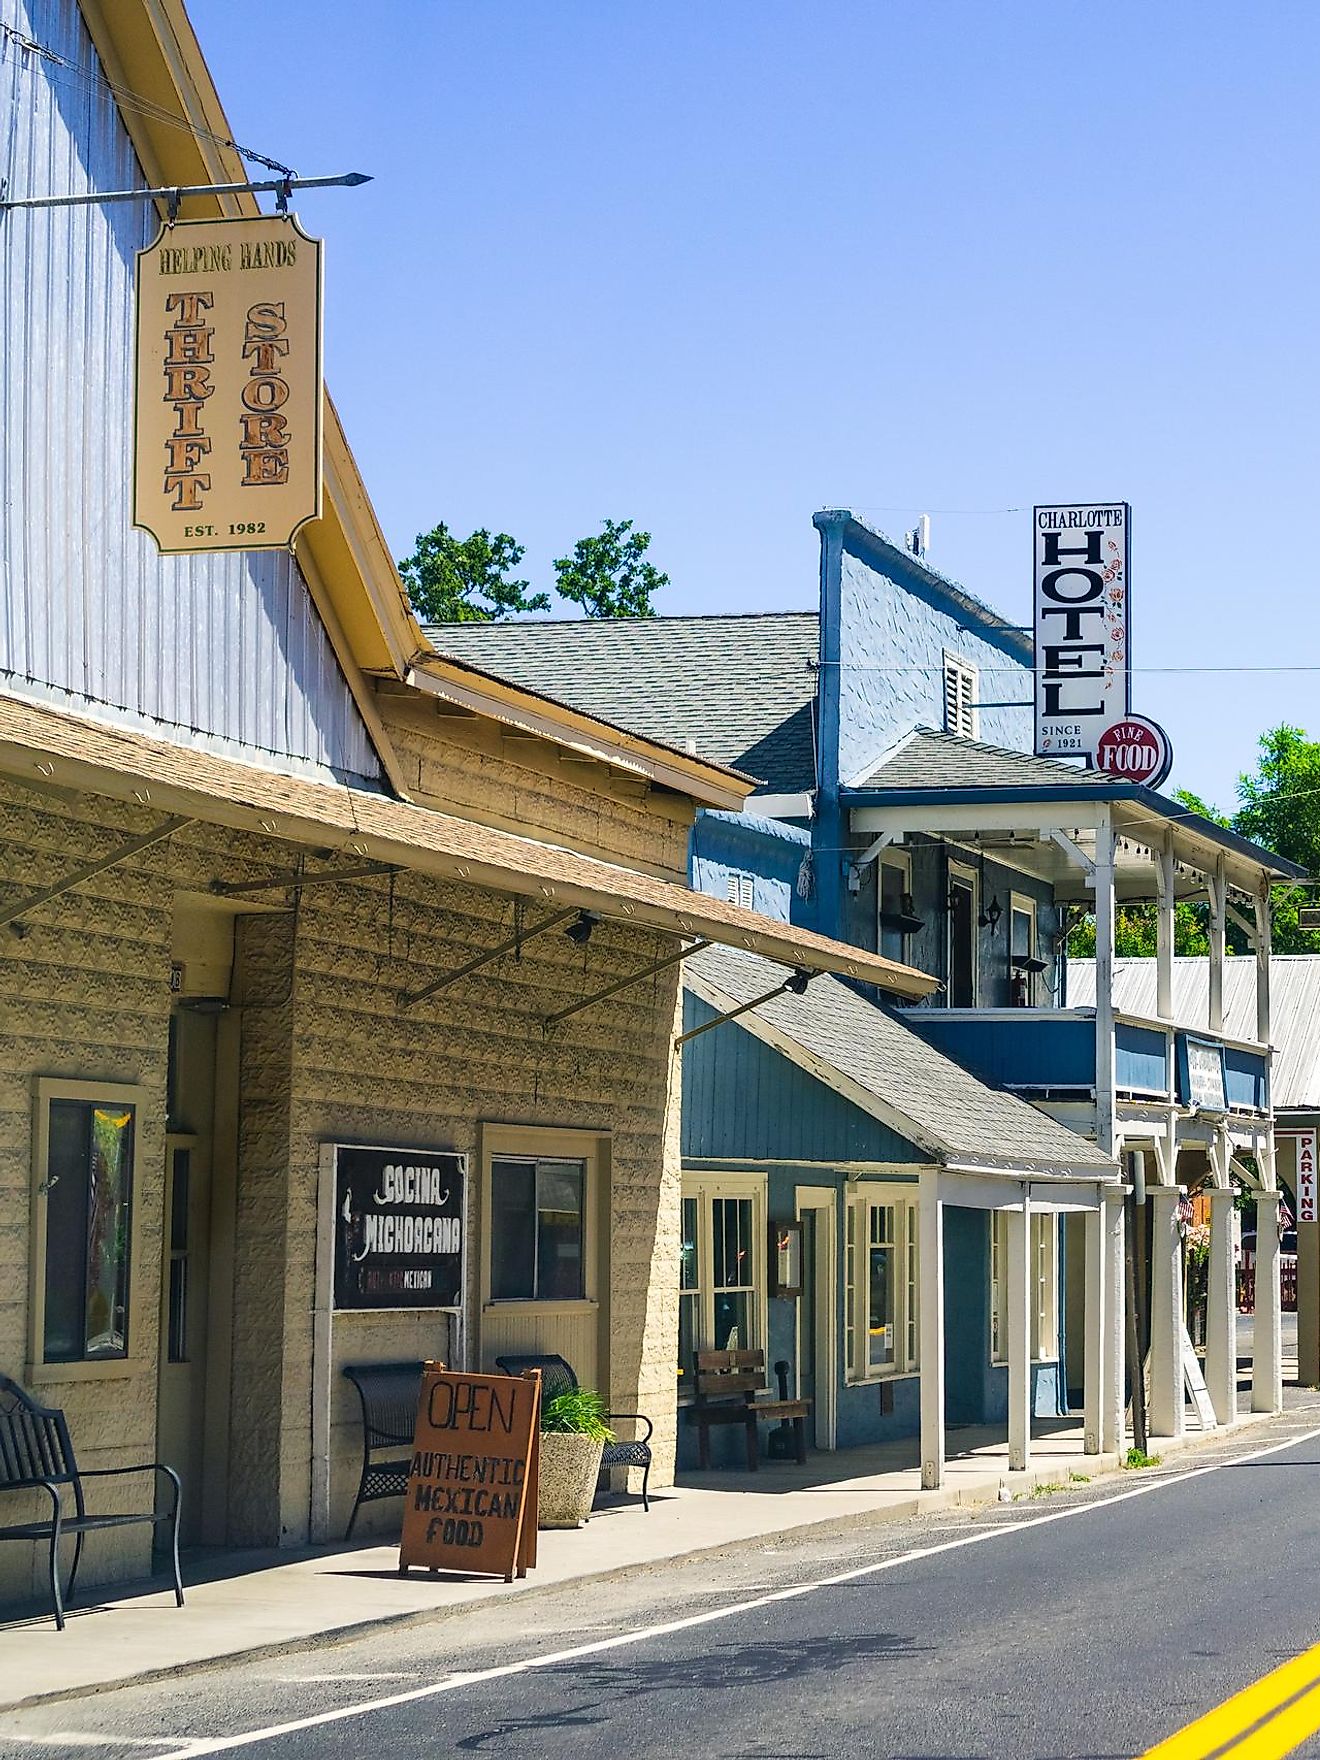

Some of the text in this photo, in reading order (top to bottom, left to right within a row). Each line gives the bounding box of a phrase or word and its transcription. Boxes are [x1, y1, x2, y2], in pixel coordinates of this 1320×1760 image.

[158, 239, 297, 276] HELPING HANDS
[163, 291, 215, 511] THRIFT
[240, 302, 291, 486] STORE
[184, 522, 266, 537] EST. 1982
[1038, 509, 1122, 529] CHARLOTTE
[1041, 530, 1104, 717] HOTEL
[1041, 725, 1081, 735] SINCE
[1057, 738, 1082, 747] 1921
[1113, 729, 1143, 741] FINE
[1102, 744, 1157, 771] FOOD
[374, 1165, 450, 1206] COCINA
[1301, 1138, 1313, 1220] PARKING
[352, 1214, 461, 1262] MICHOACANA
[429, 1380, 516, 1434] OPEN
[410, 1451, 525, 1486] AUTHENTIC
[414, 1483, 520, 1520] MEXICAN
[425, 1516, 484, 1548] FOOD
